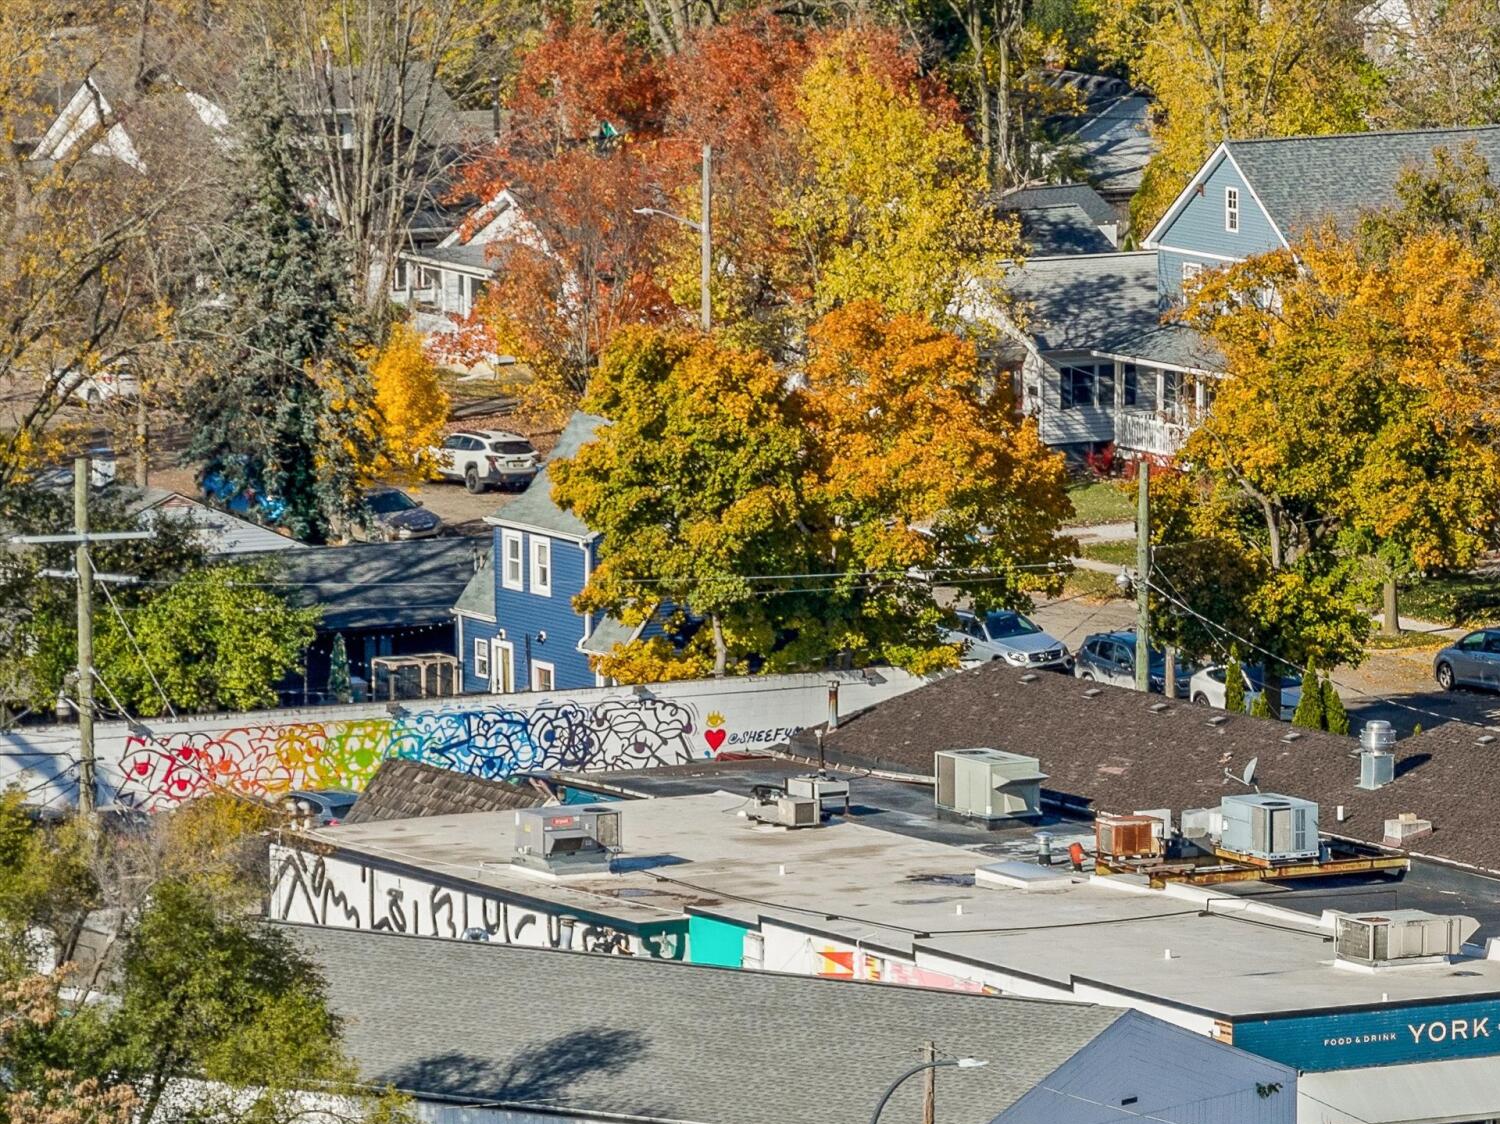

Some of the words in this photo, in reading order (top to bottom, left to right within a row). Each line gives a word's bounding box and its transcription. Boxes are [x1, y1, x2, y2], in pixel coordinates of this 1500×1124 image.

[1324, 1037, 1352, 1046] FOOD
[1364, 1033, 1397, 1043] DRINK
[1408, 1017, 1490, 1044] YORK
